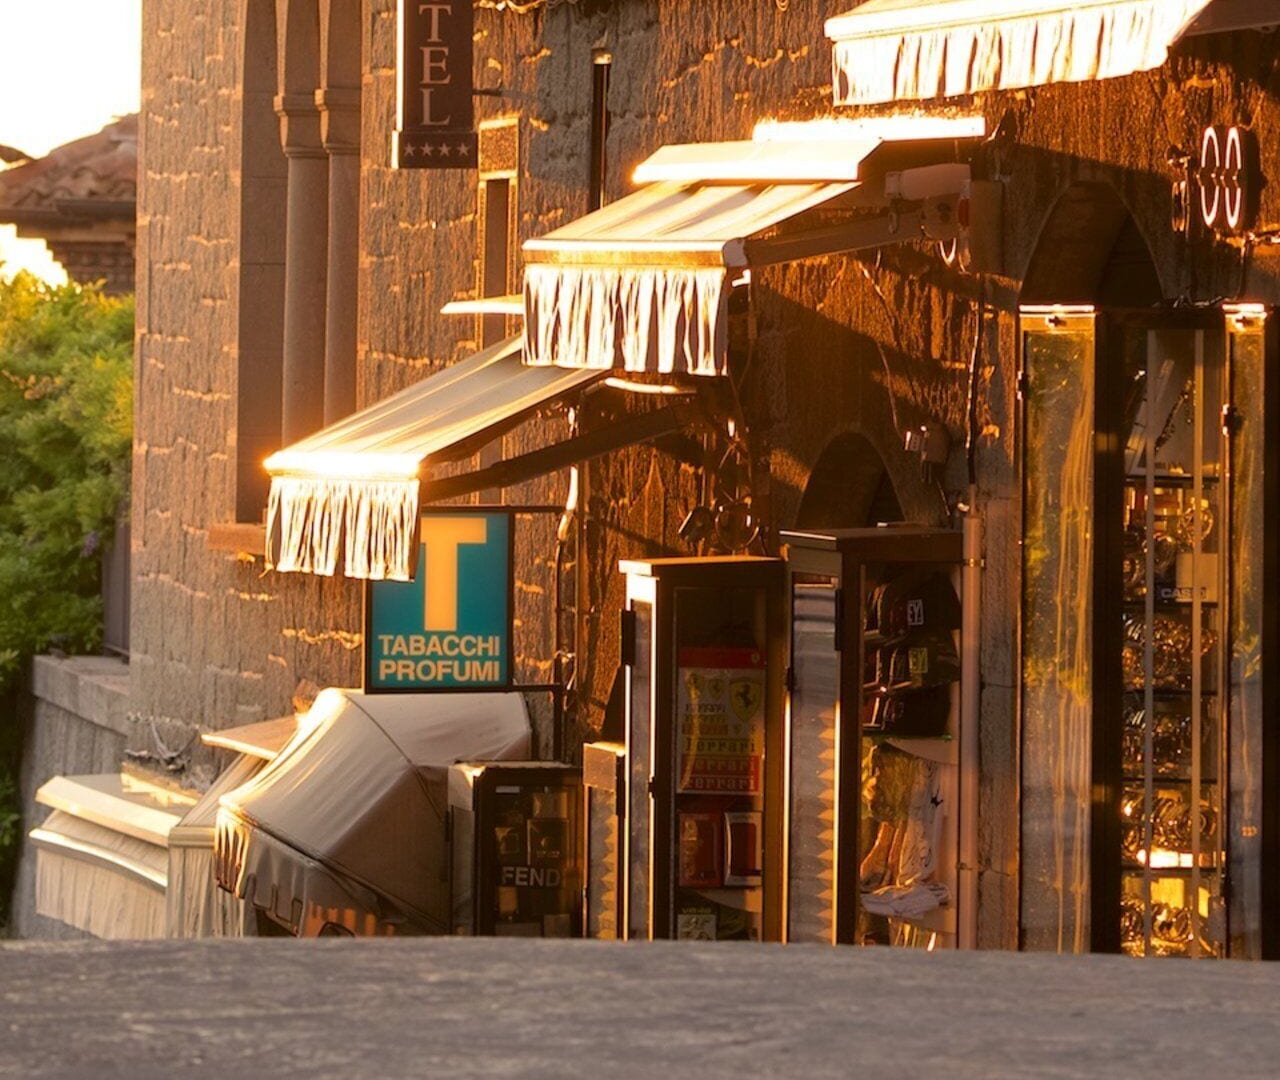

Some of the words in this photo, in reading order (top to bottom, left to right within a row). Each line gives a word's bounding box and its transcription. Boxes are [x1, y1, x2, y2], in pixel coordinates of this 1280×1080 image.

[420, 517, 487, 631] T
[378, 634, 500, 656] TABACCHI
[379, 660, 500, 681] PROFUMI
